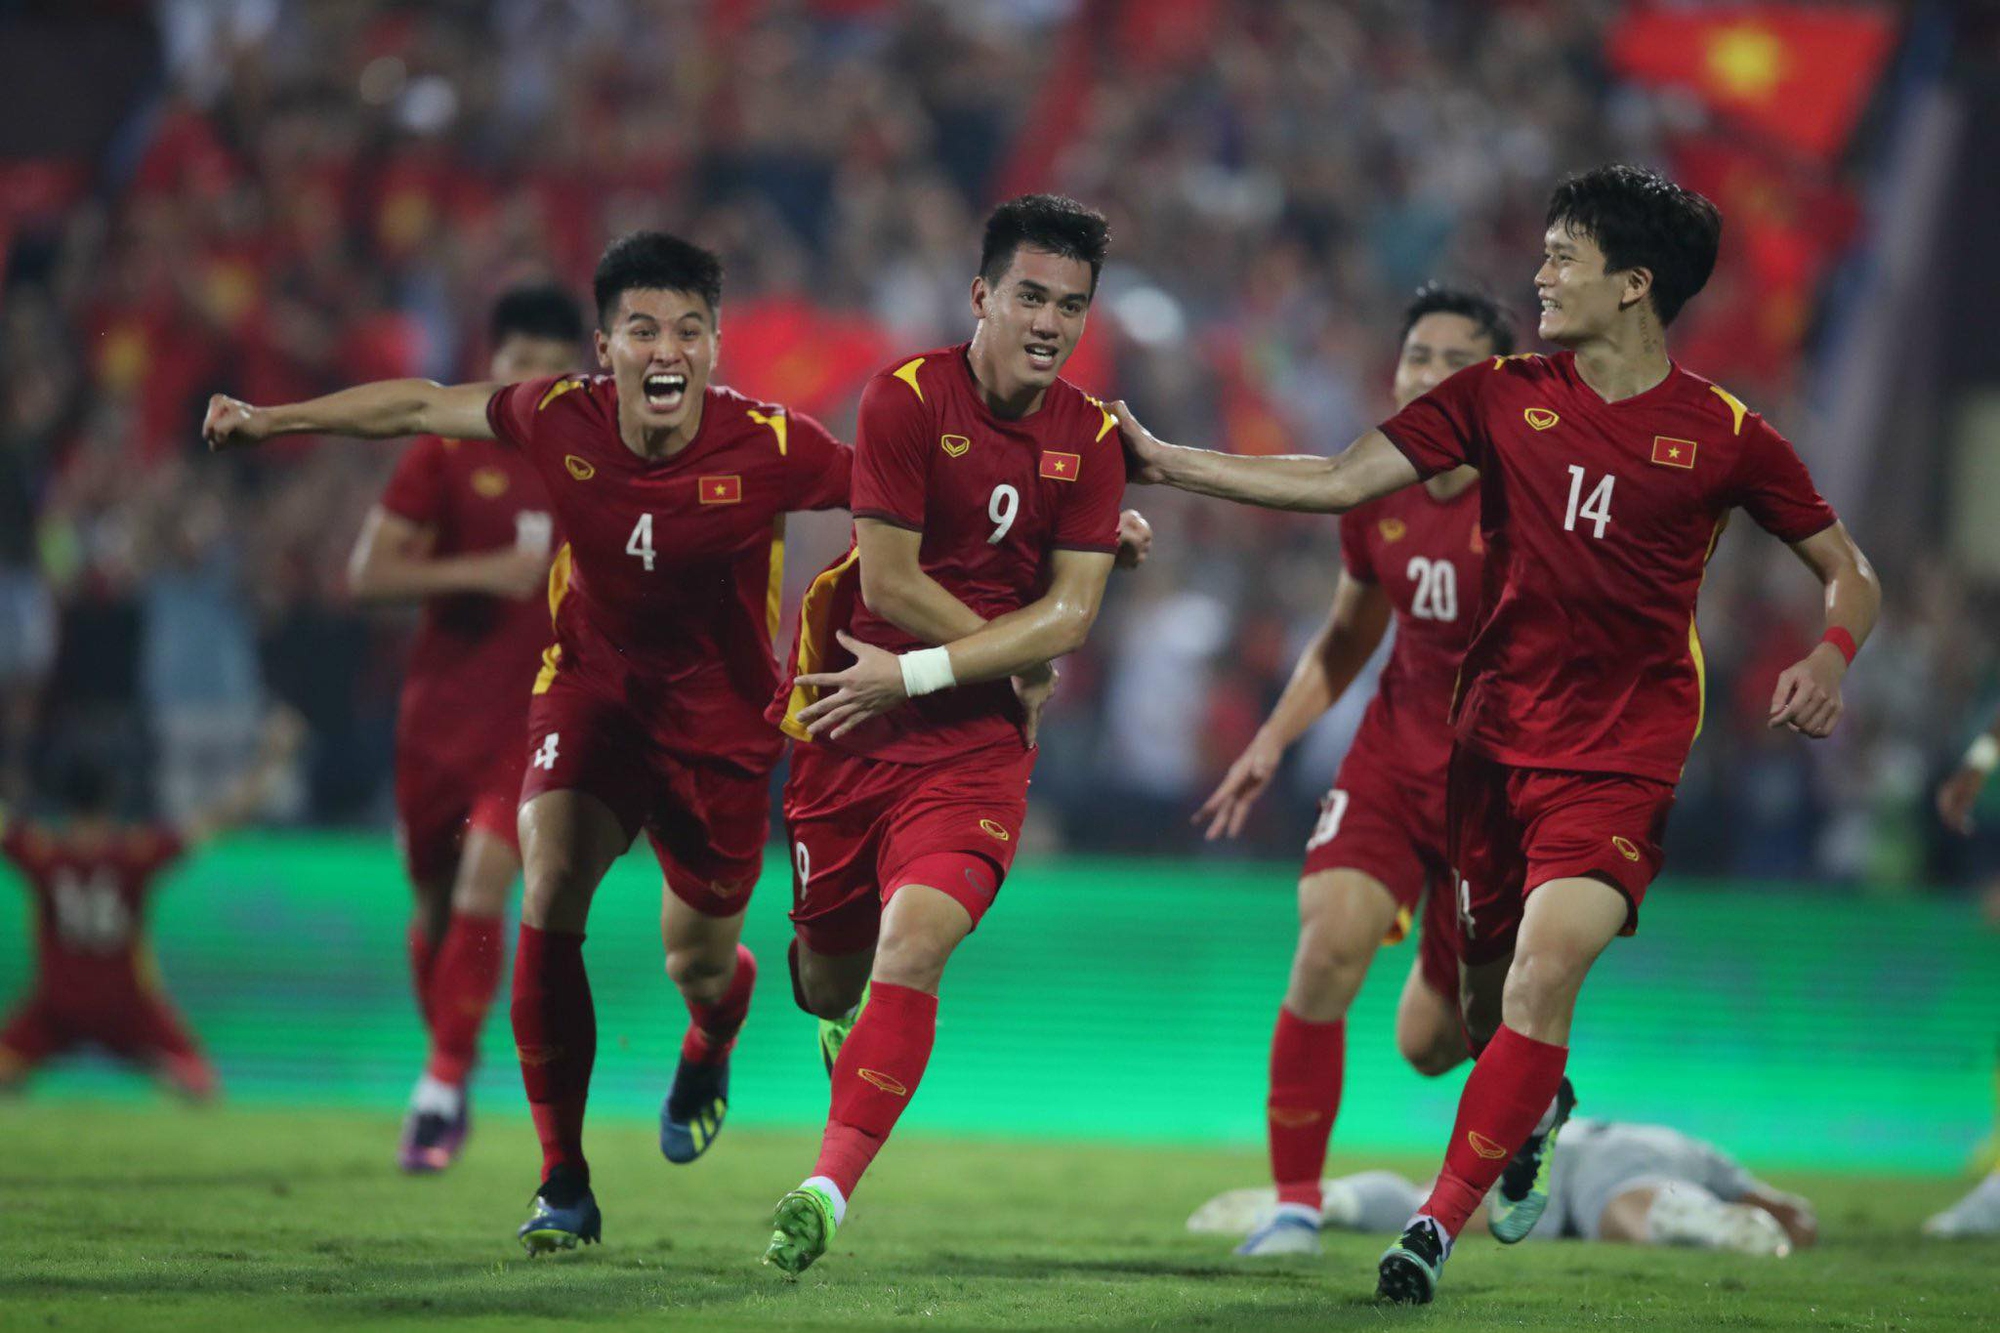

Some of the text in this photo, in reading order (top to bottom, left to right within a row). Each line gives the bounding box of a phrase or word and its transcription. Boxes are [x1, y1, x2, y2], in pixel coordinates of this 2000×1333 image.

[986, 483, 1020, 545] 9
[1564, 464, 1616, 539] 14
[625, 512, 657, 571] 4
[1406, 555, 1457, 622] 20
[534, 732, 559, 770] 4
[795, 841, 810, 902] 9
